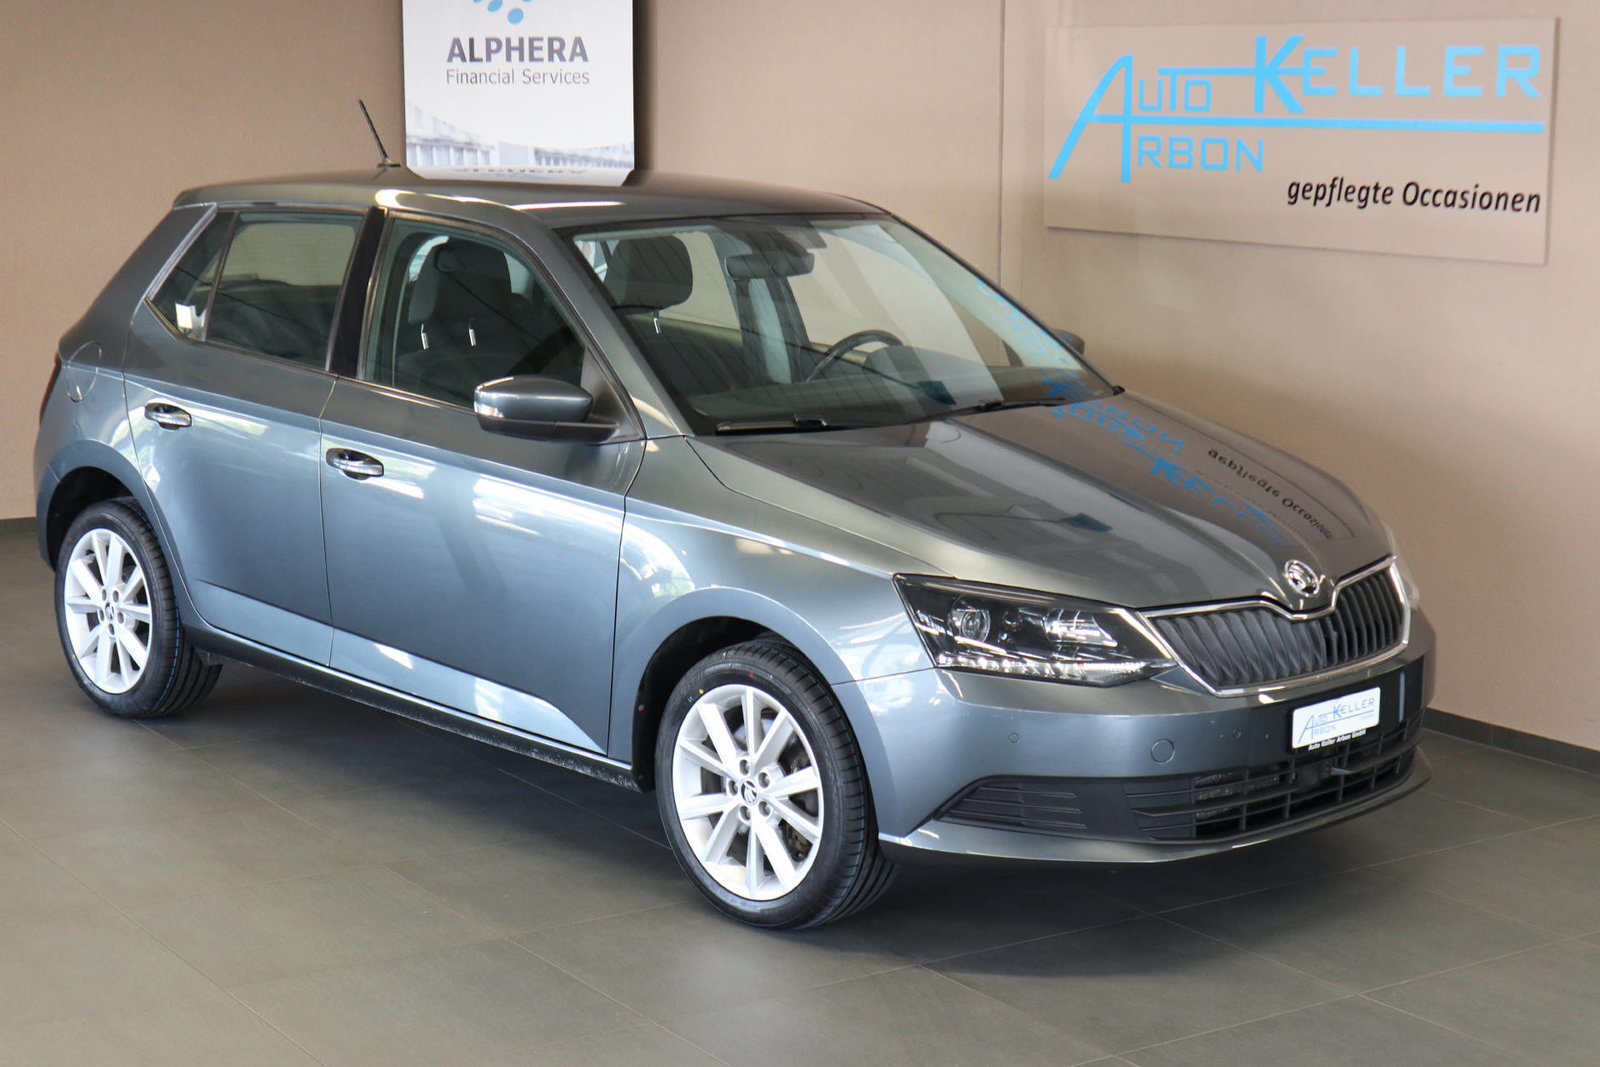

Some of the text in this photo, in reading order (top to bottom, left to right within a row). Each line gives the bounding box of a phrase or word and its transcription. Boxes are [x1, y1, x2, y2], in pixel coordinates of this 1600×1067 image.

[446, 36, 589, 63] ALPHERA
[446, 68, 590, 85] Financial Services
[1253, 34, 1541, 113] KELLER
[1287, 177, 1541, 213] gepflegte Occasionen
[1333, 698, 1374, 720] KELLER
